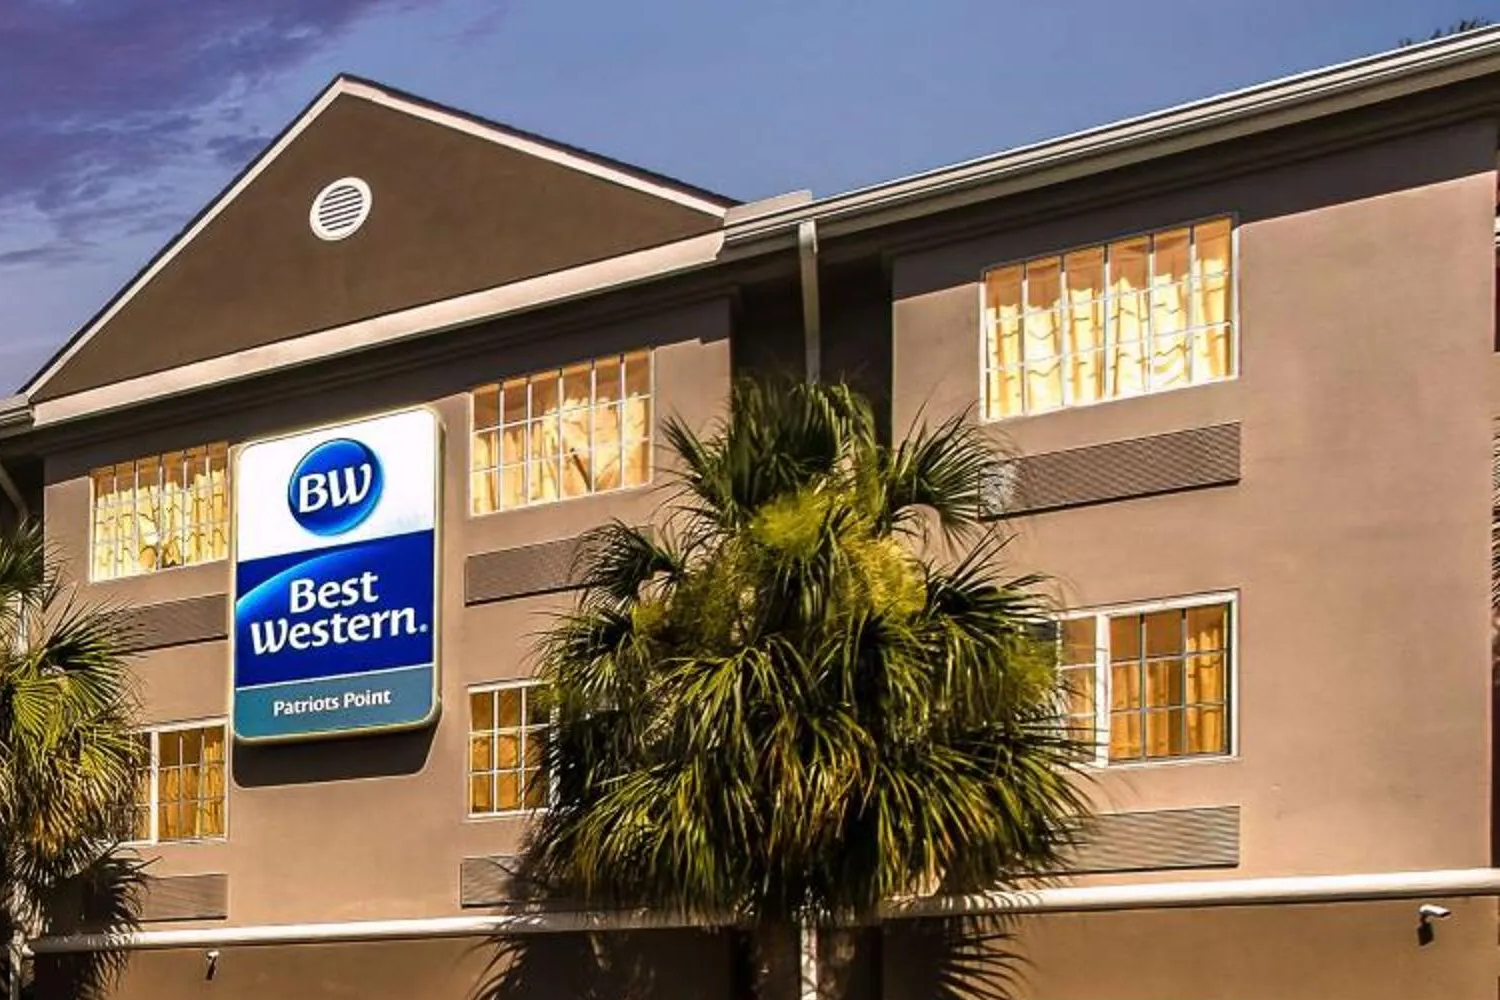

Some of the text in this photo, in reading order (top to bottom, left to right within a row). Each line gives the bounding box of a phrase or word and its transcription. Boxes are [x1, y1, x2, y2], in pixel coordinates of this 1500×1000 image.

[298, 463, 373, 513] BW
[290, 571, 379, 614] Best
[273, 688, 393, 717] Patriots Point
